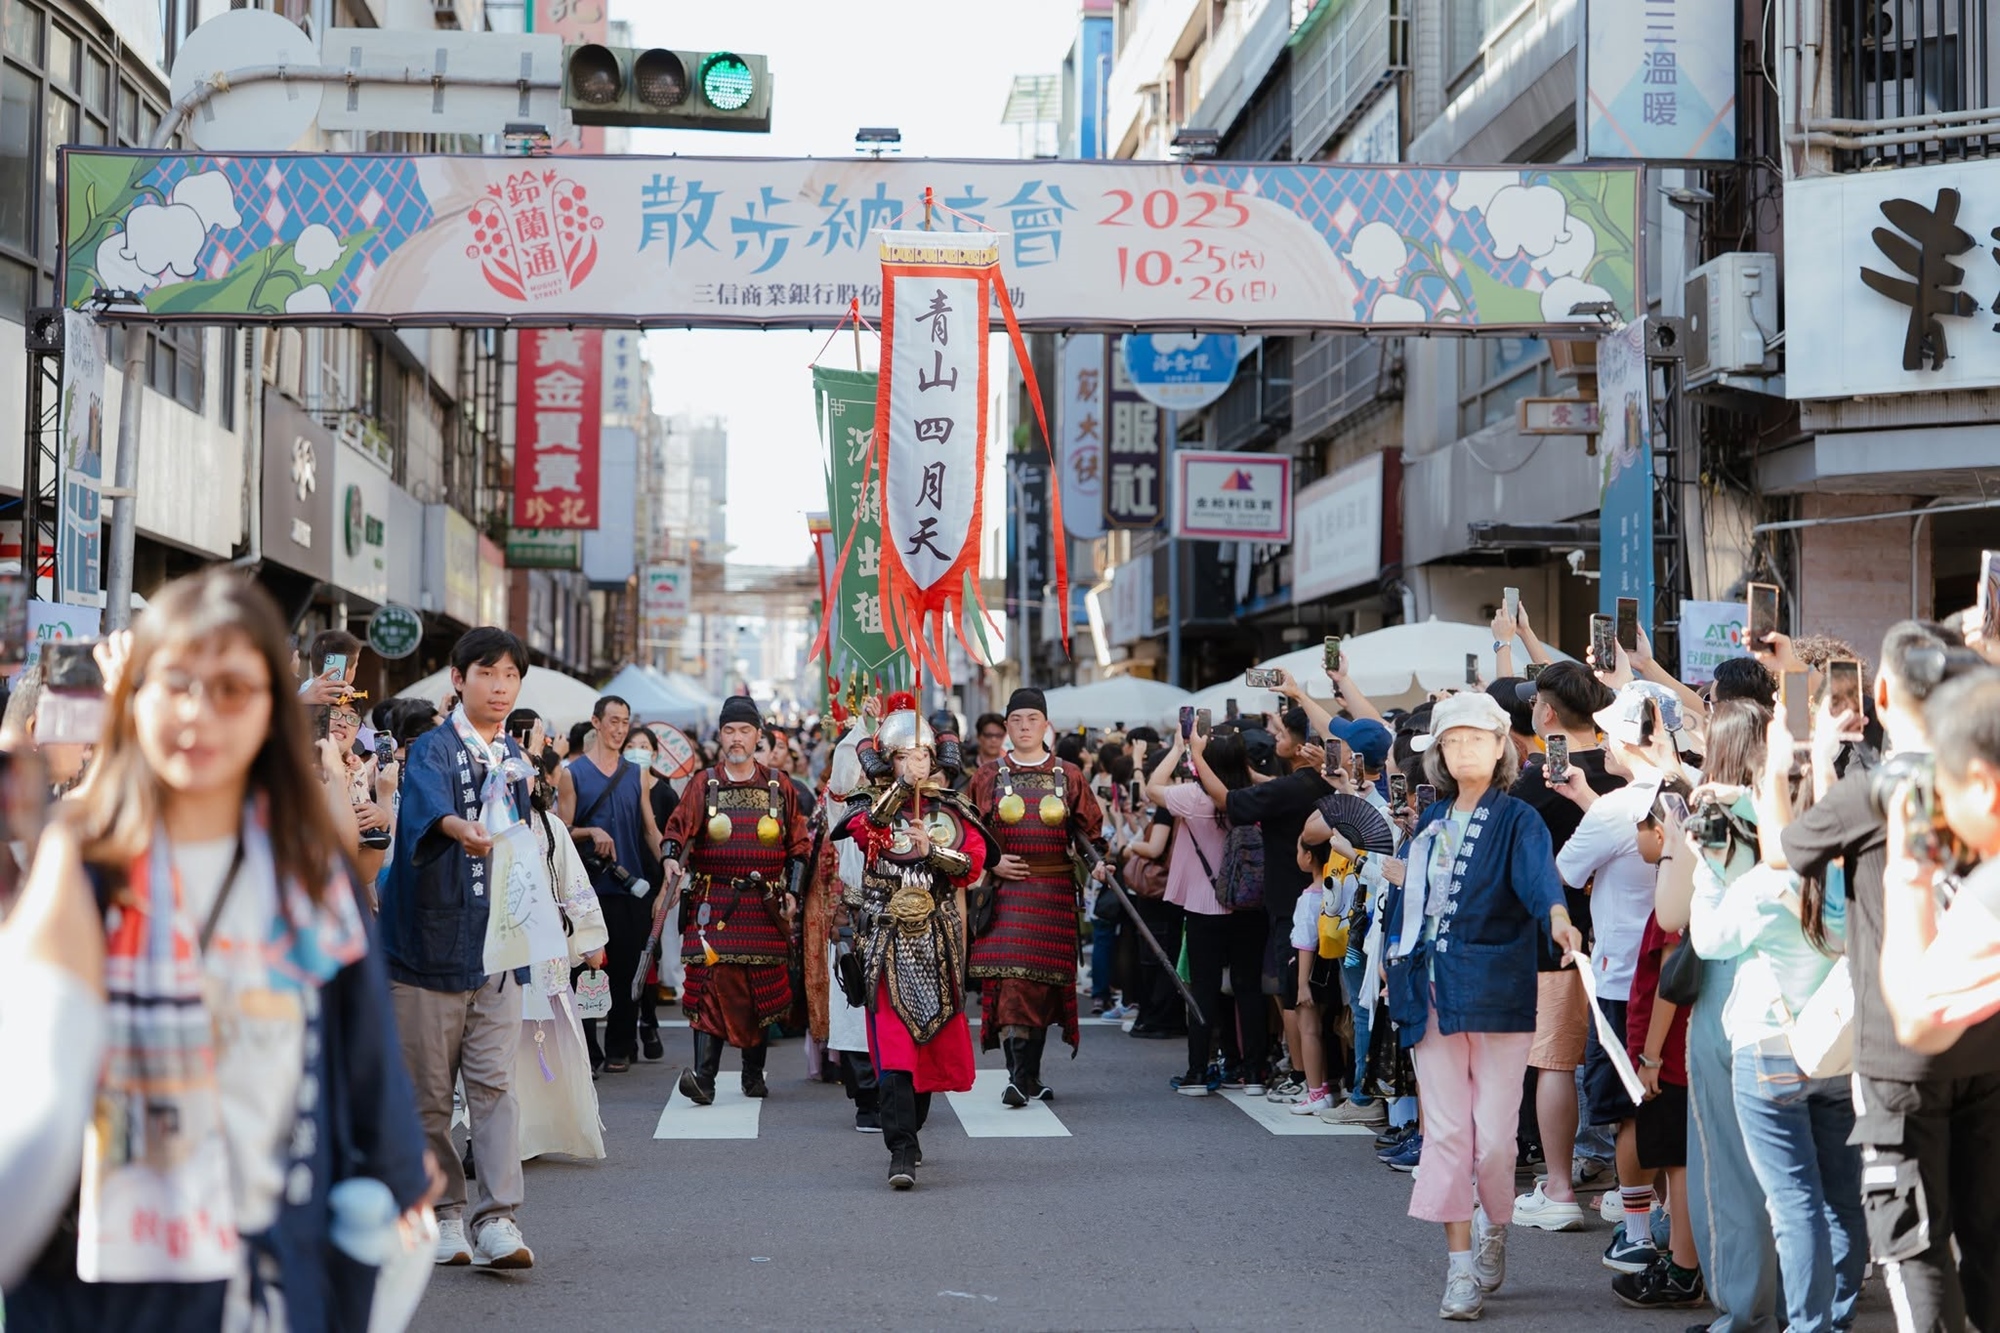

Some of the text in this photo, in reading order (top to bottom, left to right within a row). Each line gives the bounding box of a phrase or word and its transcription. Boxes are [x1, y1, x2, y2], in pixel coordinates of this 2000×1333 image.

[1643, 0, 1678, 126] 三溫暖
[505, 170, 560, 279] 鈴蘭通
[1096, 189, 1251, 229] 2025
[530, 279, 563, 292] MUGUET
[534, 289, 563, 300] STREET
[904, 288, 958, 561] 青山四月天
[456, 750, 485, 897] 鈴蘭通散涼會
